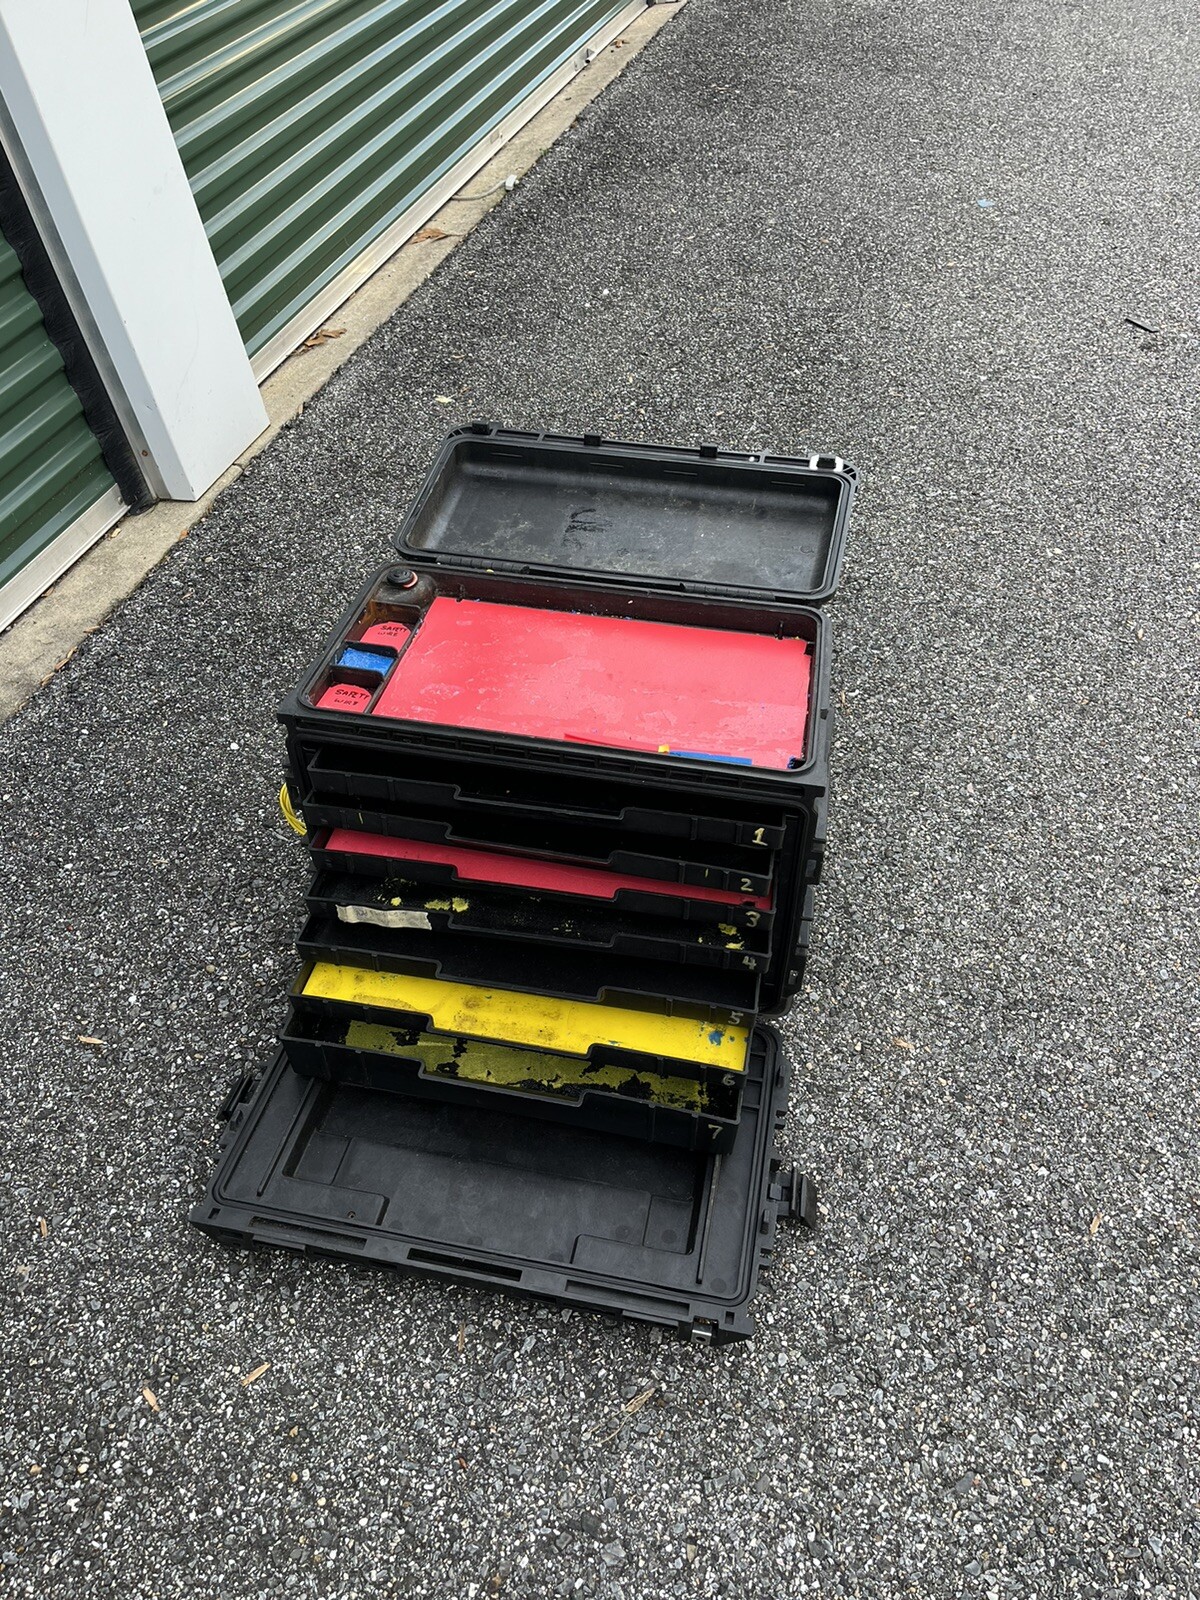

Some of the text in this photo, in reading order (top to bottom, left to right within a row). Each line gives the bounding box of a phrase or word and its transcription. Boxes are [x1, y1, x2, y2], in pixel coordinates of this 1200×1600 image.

[752, 827, 768, 846] 1
[740, 877, 754, 892] 2
[745, 910, 761, 928] 3
[742, 955, 757, 970] 4
[728, 1010, 744, 1025] 5
[721, 1073, 736, 1086] 6
[708, 1123, 724, 1140] 7
